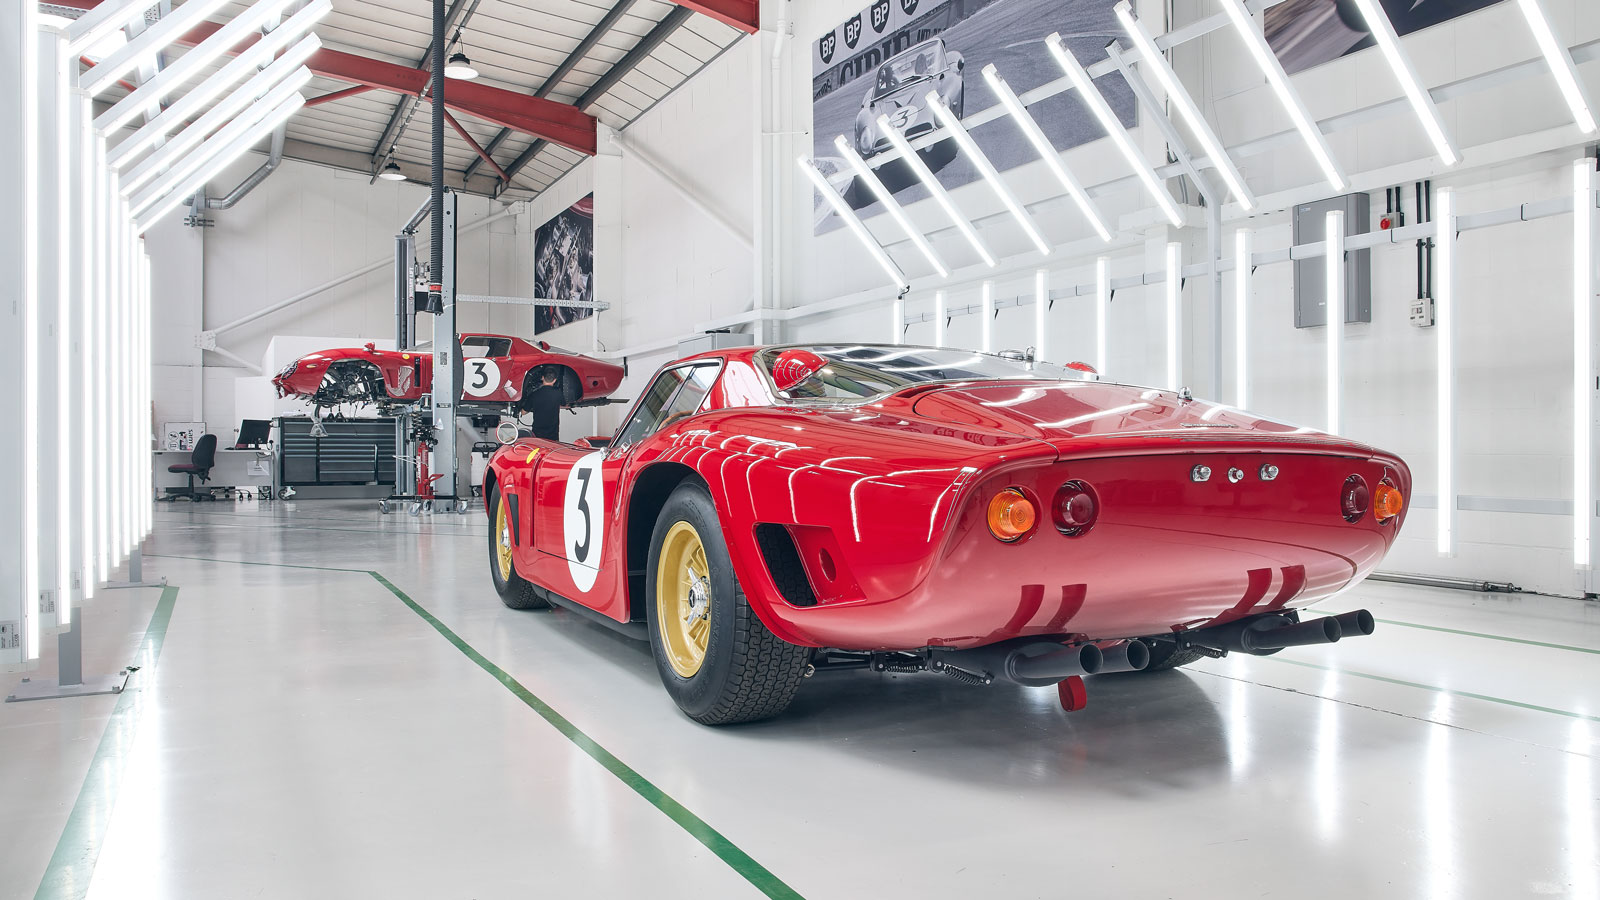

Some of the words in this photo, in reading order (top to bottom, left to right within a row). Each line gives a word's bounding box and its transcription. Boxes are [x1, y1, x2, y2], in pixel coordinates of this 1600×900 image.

[873, 2, 888, 28] BP
[846, 19, 860, 44] BP
[821, 36, 835, 59] BP
[896, 109, 909, 128] 3
[471, 362, 488, 389] 3
[574, 467, 593, 563] 3
